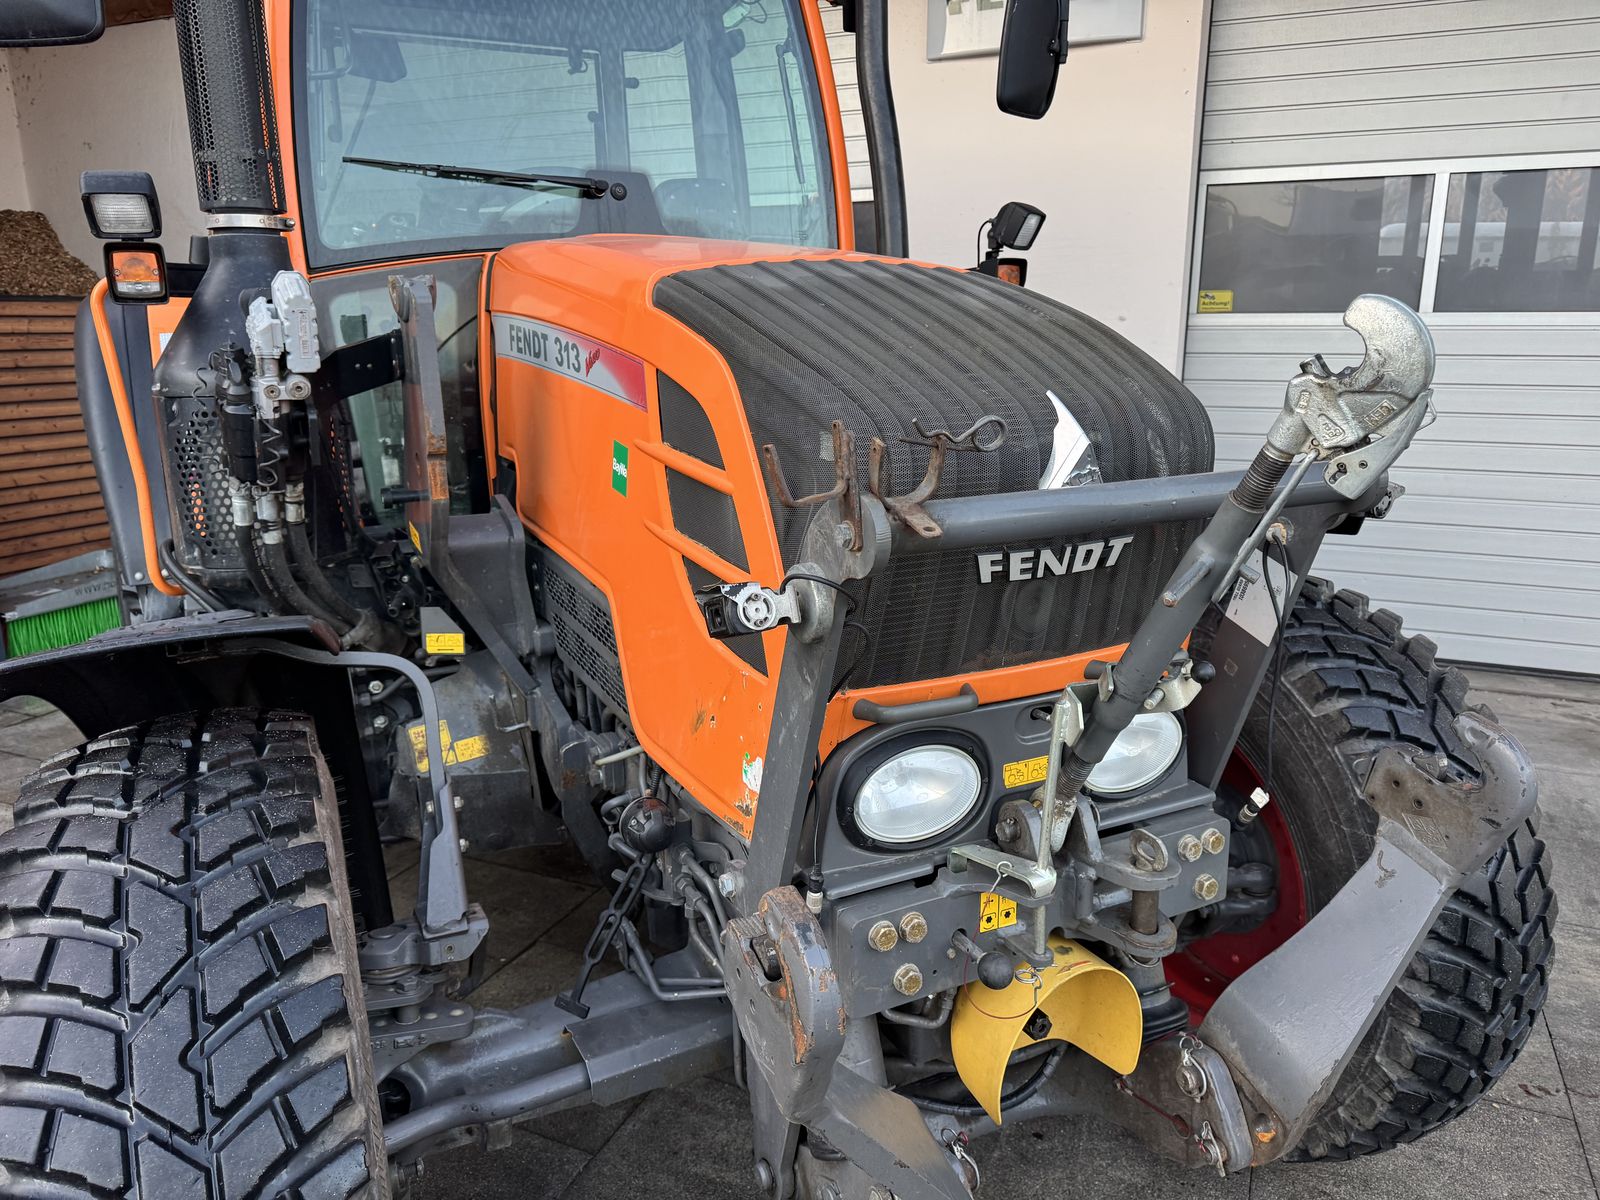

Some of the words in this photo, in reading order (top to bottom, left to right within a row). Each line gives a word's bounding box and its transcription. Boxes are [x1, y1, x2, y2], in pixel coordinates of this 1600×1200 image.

[509, 323, 549, 362] FENDT
[554, 336, 581, 373] 313
[612, 457, 628, 478] BayWa
[977, 535, 1134, 583] FENDT
